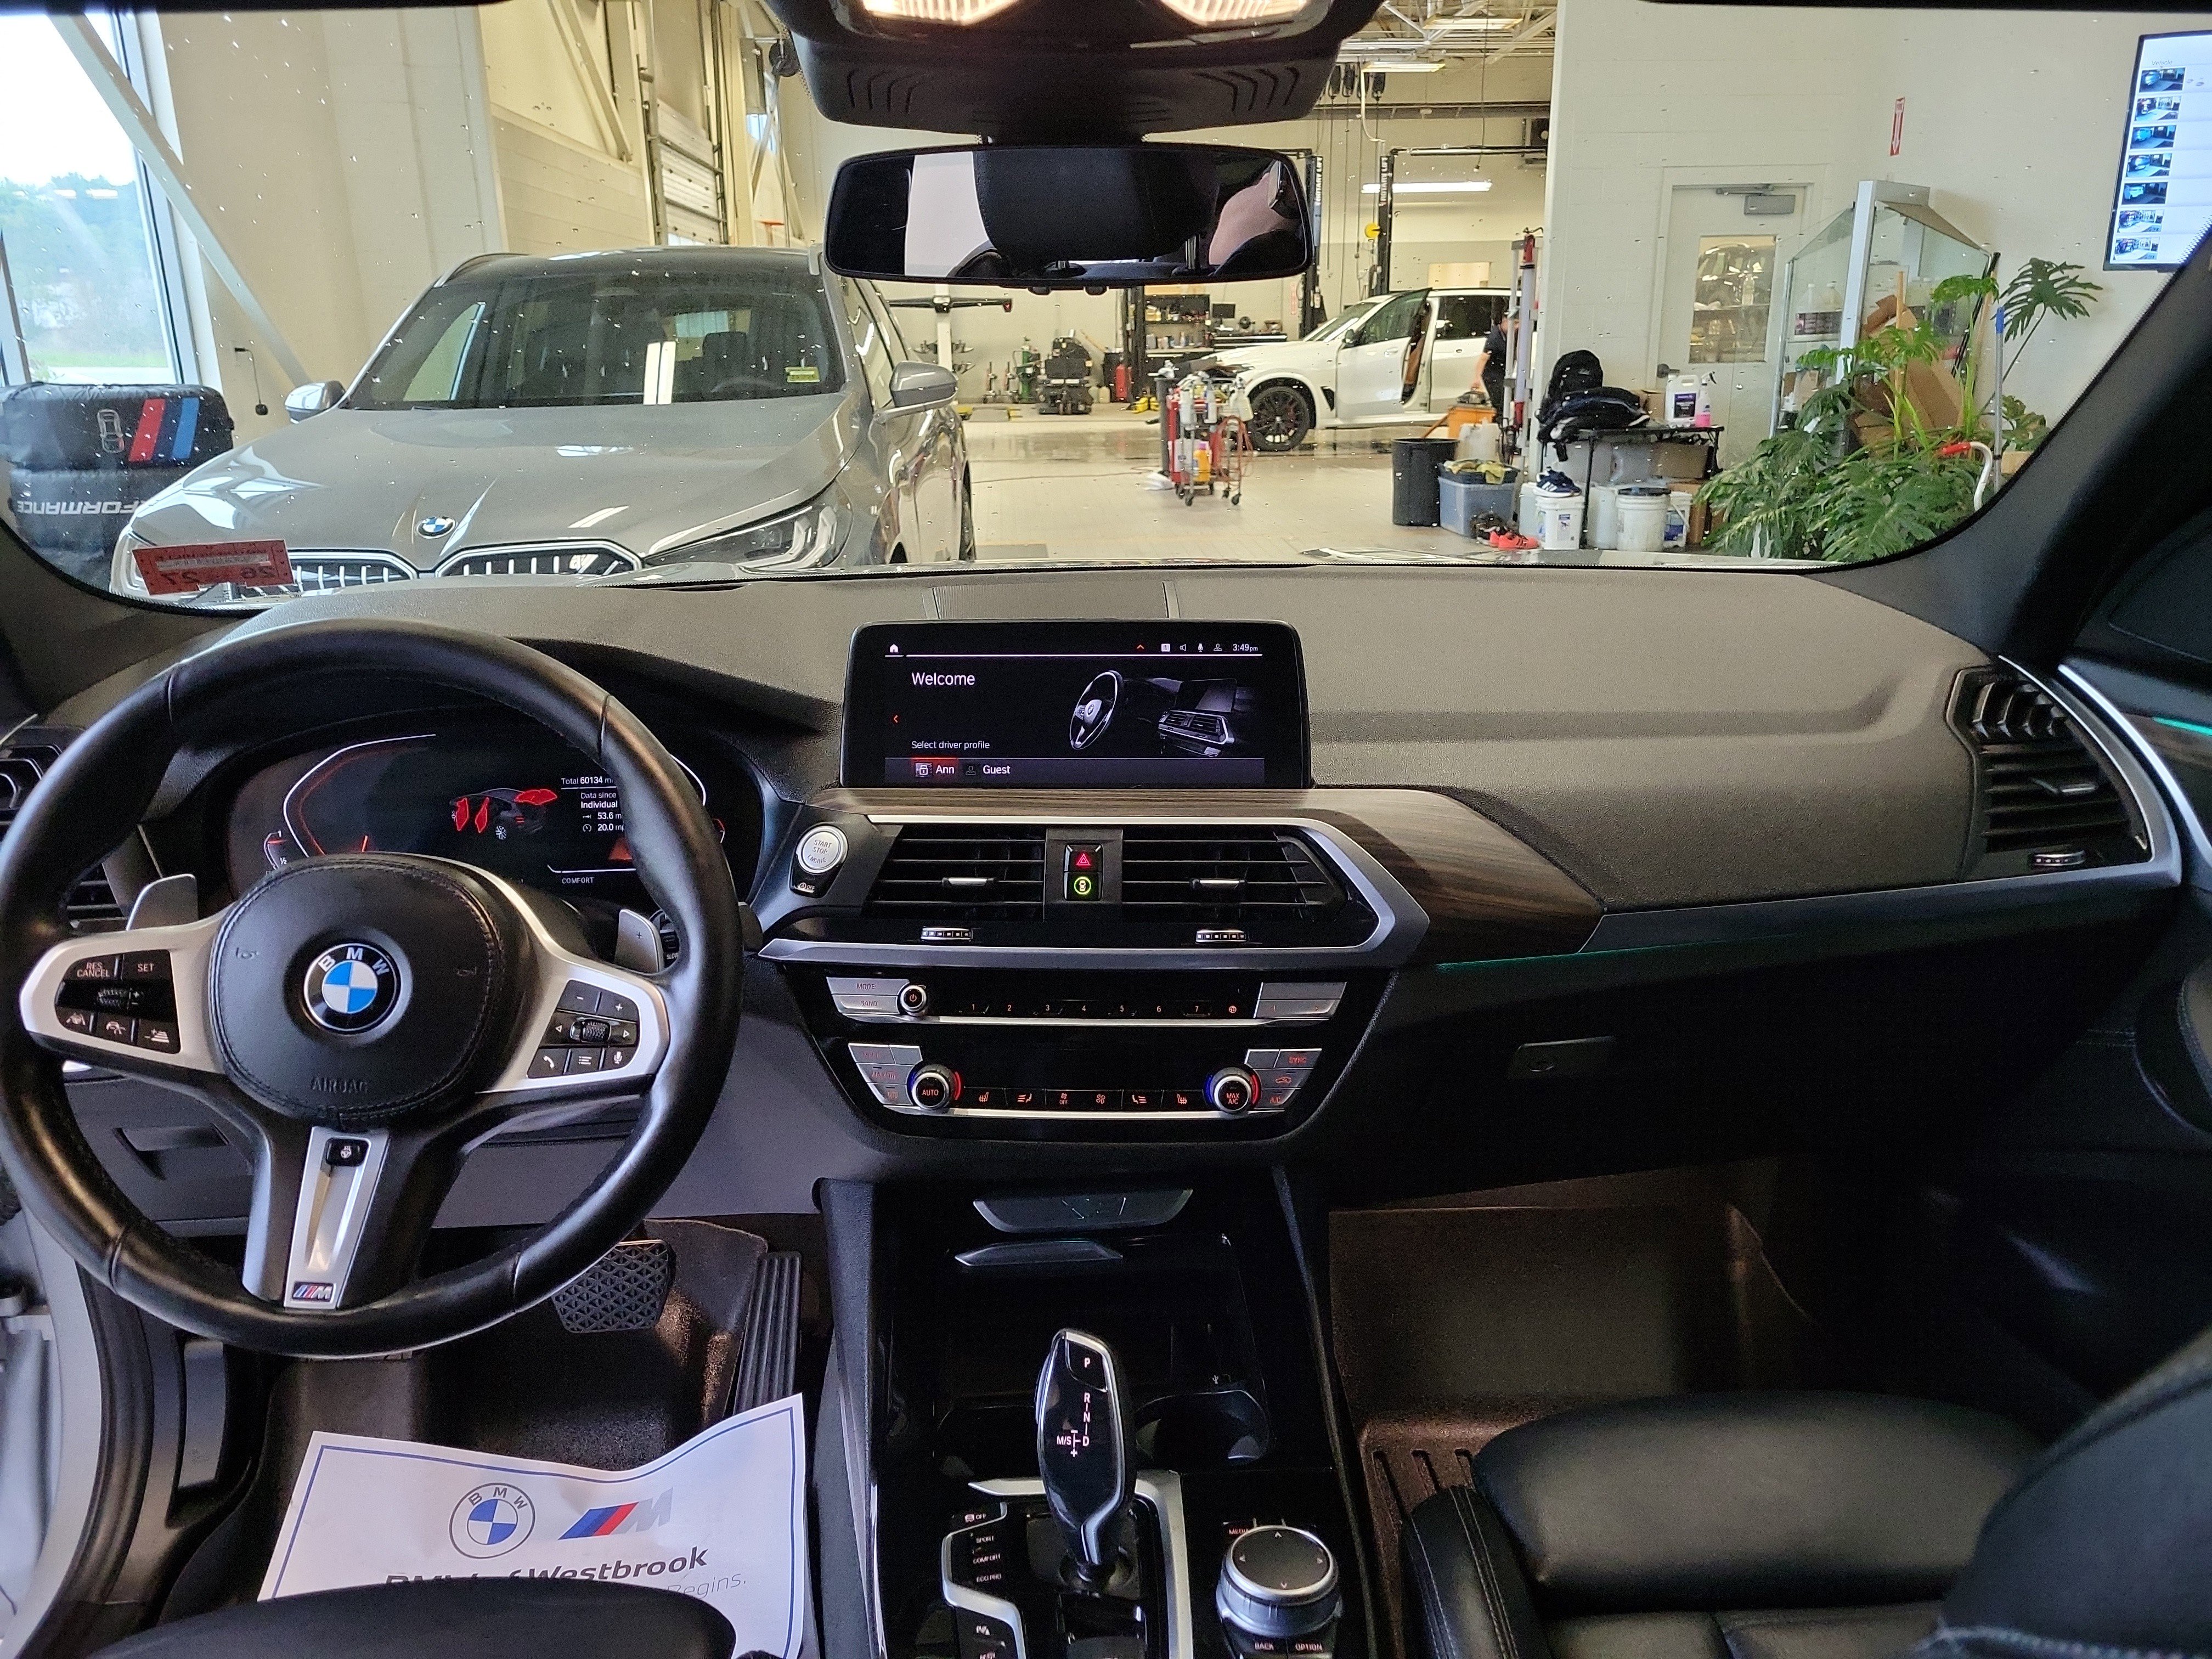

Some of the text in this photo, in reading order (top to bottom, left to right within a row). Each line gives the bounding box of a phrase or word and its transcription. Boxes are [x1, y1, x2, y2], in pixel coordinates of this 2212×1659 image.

[911, 672, 975, 685] Welcome
[911, 741, 990, 750] Select driver profile
[935, 765, 1011, 774] Ann Guest
[580, 776, 603, 785] 60134
[580, 800, 618, 809] Individual
[597, 812, 614, 820] 53.6
[814, 839, 832, 849] START
[812, 847, 828, 855] STOP
[807, 854, 827, 864] ENGINE
[86, 961, 103, 970] RES
[318, 946, 390, 976] BMW
[138, 963, 154, 973] SET
[77, 969, 110, 978] CANCEL
[1084, 1357, 1091, 1368] P
[1084, 1392, 1091, 1403] R
[1083, 1412, 1090, 1423] N
[1057, 1434, 1090, 1447] M/S D
[467, 1486, 528, 1510] BMW
[973, 1553, 1001, 1564] COMFORT
[1254, 1641, 1274, 1651] BACK
[1295, 1643, 1323, 1651] OPTION
